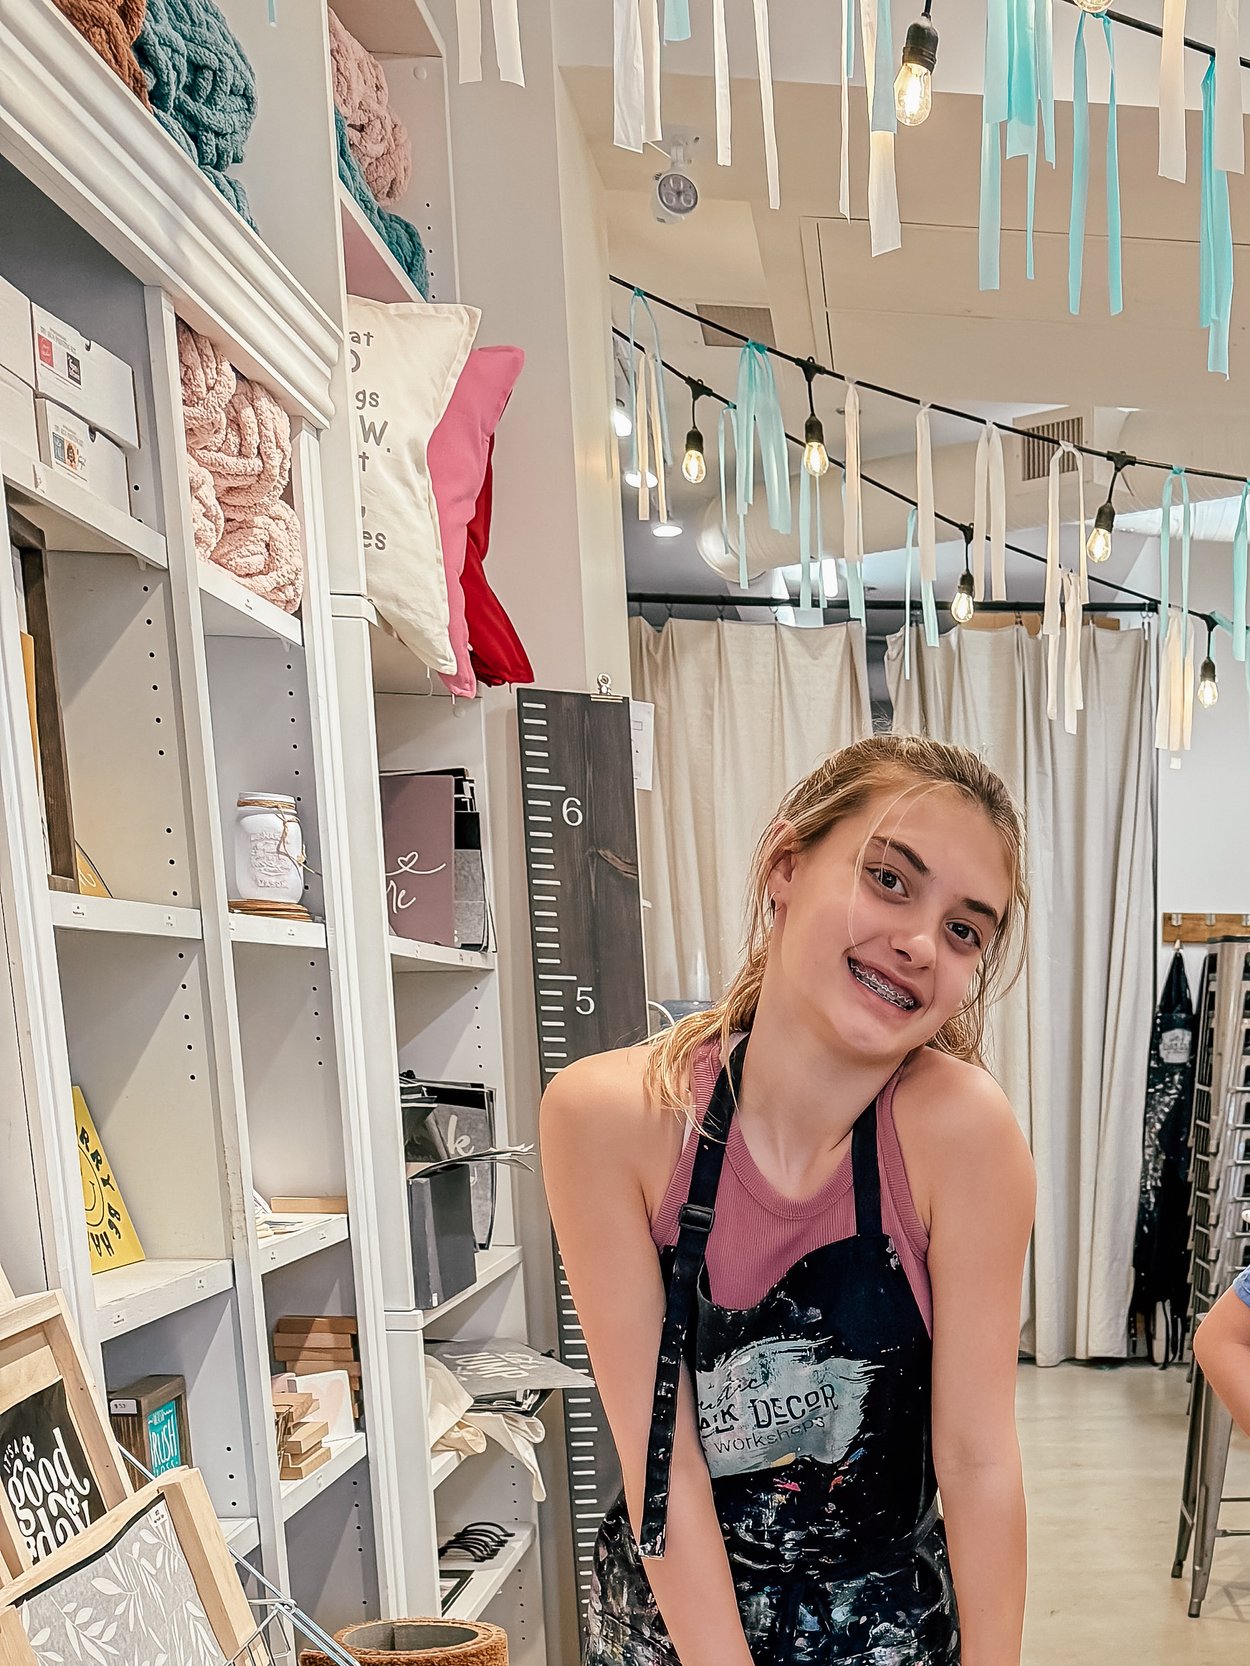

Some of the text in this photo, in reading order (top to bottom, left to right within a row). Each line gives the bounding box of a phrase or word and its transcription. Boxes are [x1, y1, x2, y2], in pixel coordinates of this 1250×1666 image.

[562, 797, 583, 826] 6
[575, 986, 595, 1015] 5
[748, 1383, 839, 1429] DECOR
[713, 1416, 826, 1454] workshops
[7, 1427, 90, 1537] good
